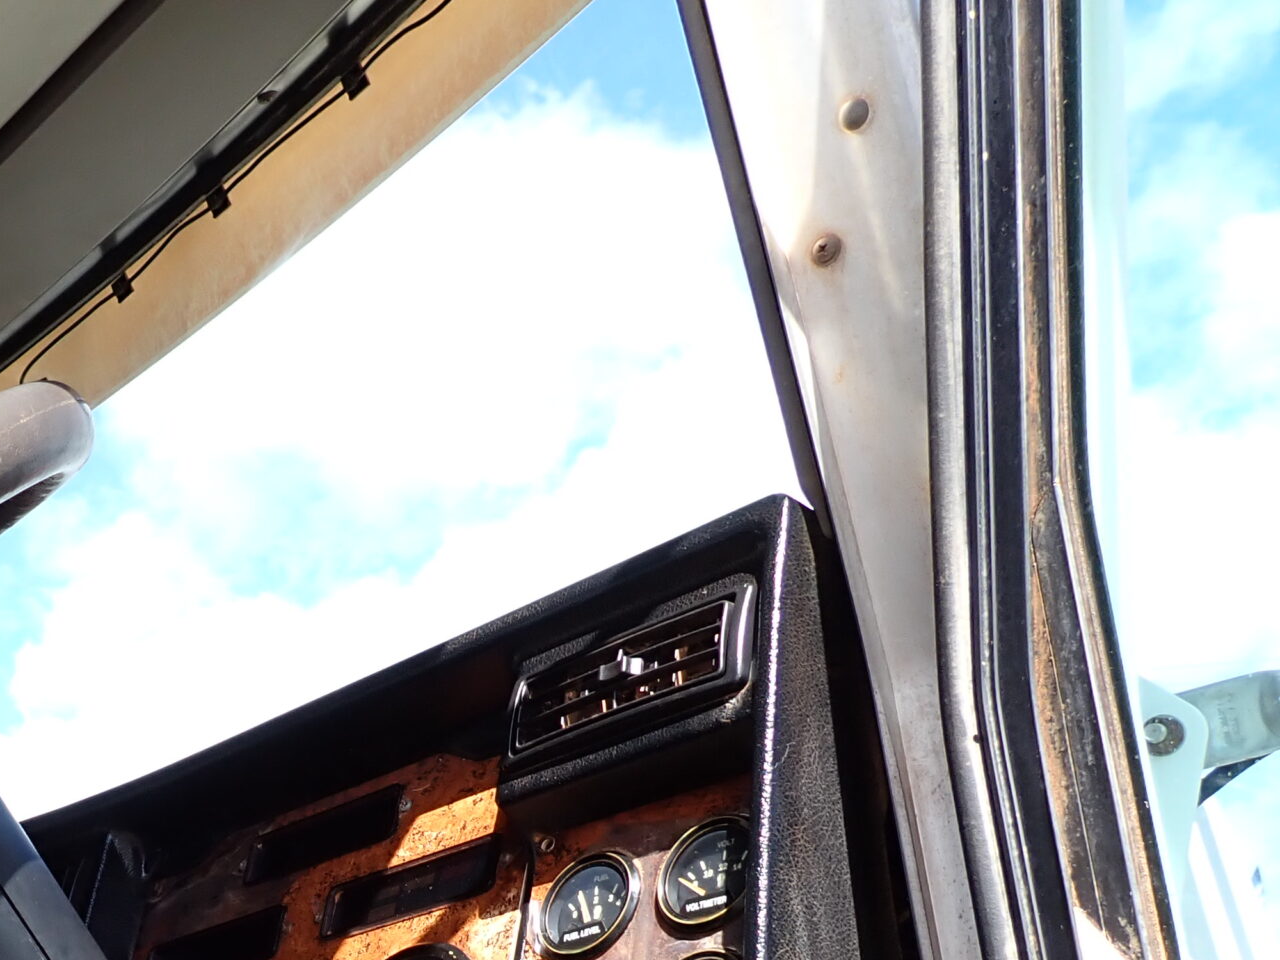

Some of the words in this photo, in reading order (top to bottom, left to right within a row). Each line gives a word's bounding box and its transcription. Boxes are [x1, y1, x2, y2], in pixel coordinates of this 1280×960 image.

[717, 837, 735, 848] VOLT
[733, 862, 742, 871] 14
[593, 873, 609, 883] FUEL
[685, 895, 727, 913] VOLTMETER
[563, 931, 580, 943] FUEL
[579, 925, 601, 937] LEVEL
